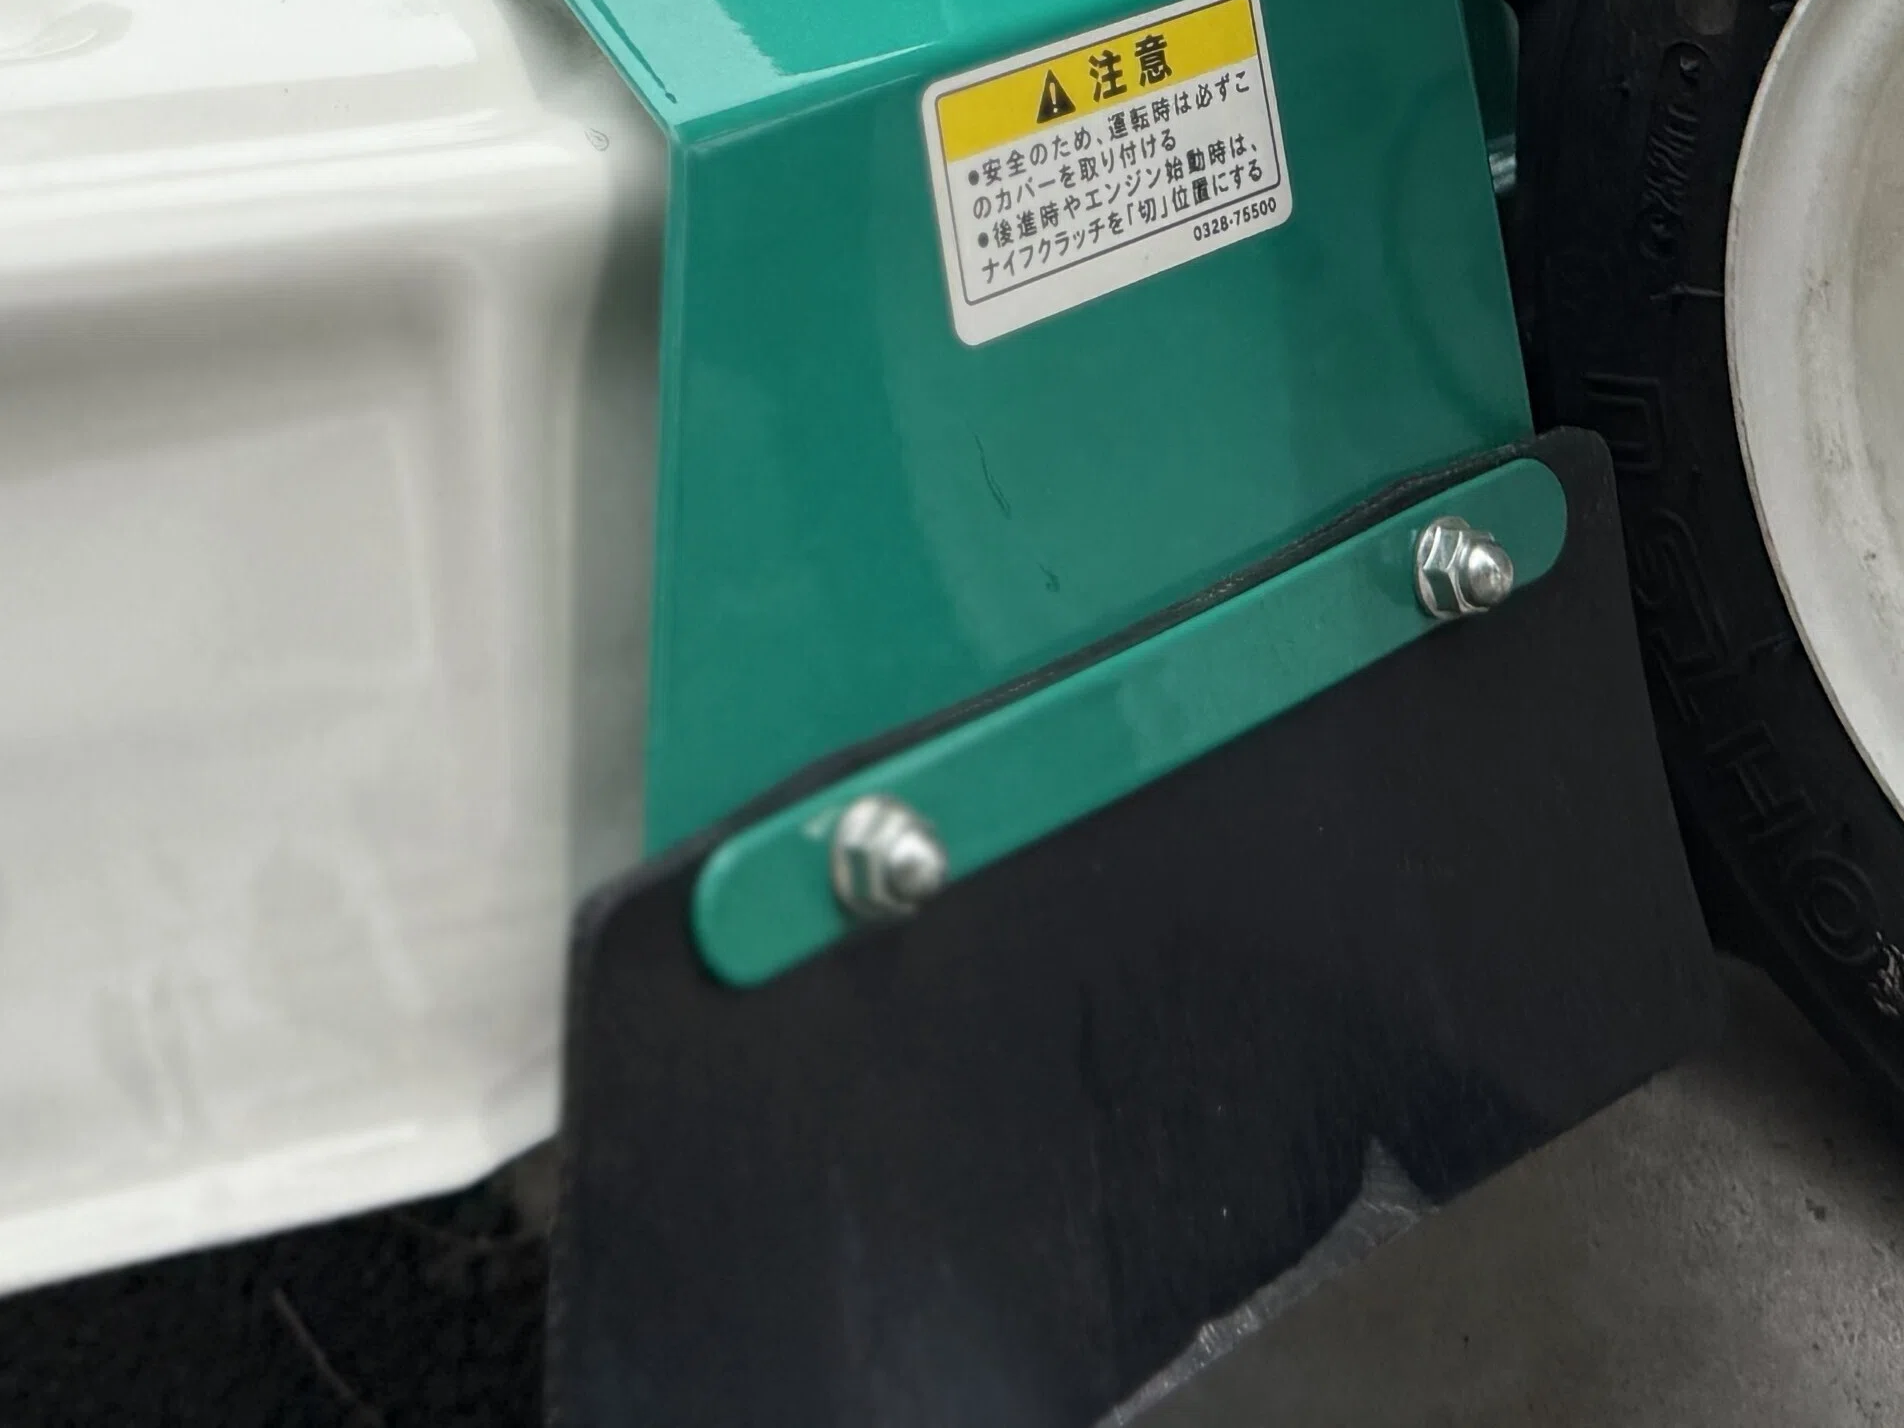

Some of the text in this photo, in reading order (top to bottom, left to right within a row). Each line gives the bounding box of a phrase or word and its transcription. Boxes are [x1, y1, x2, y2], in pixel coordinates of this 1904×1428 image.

[1087, 33, 1174, 104] 注意
[972, 128, 1178, 221] のカバーを取り付ける
